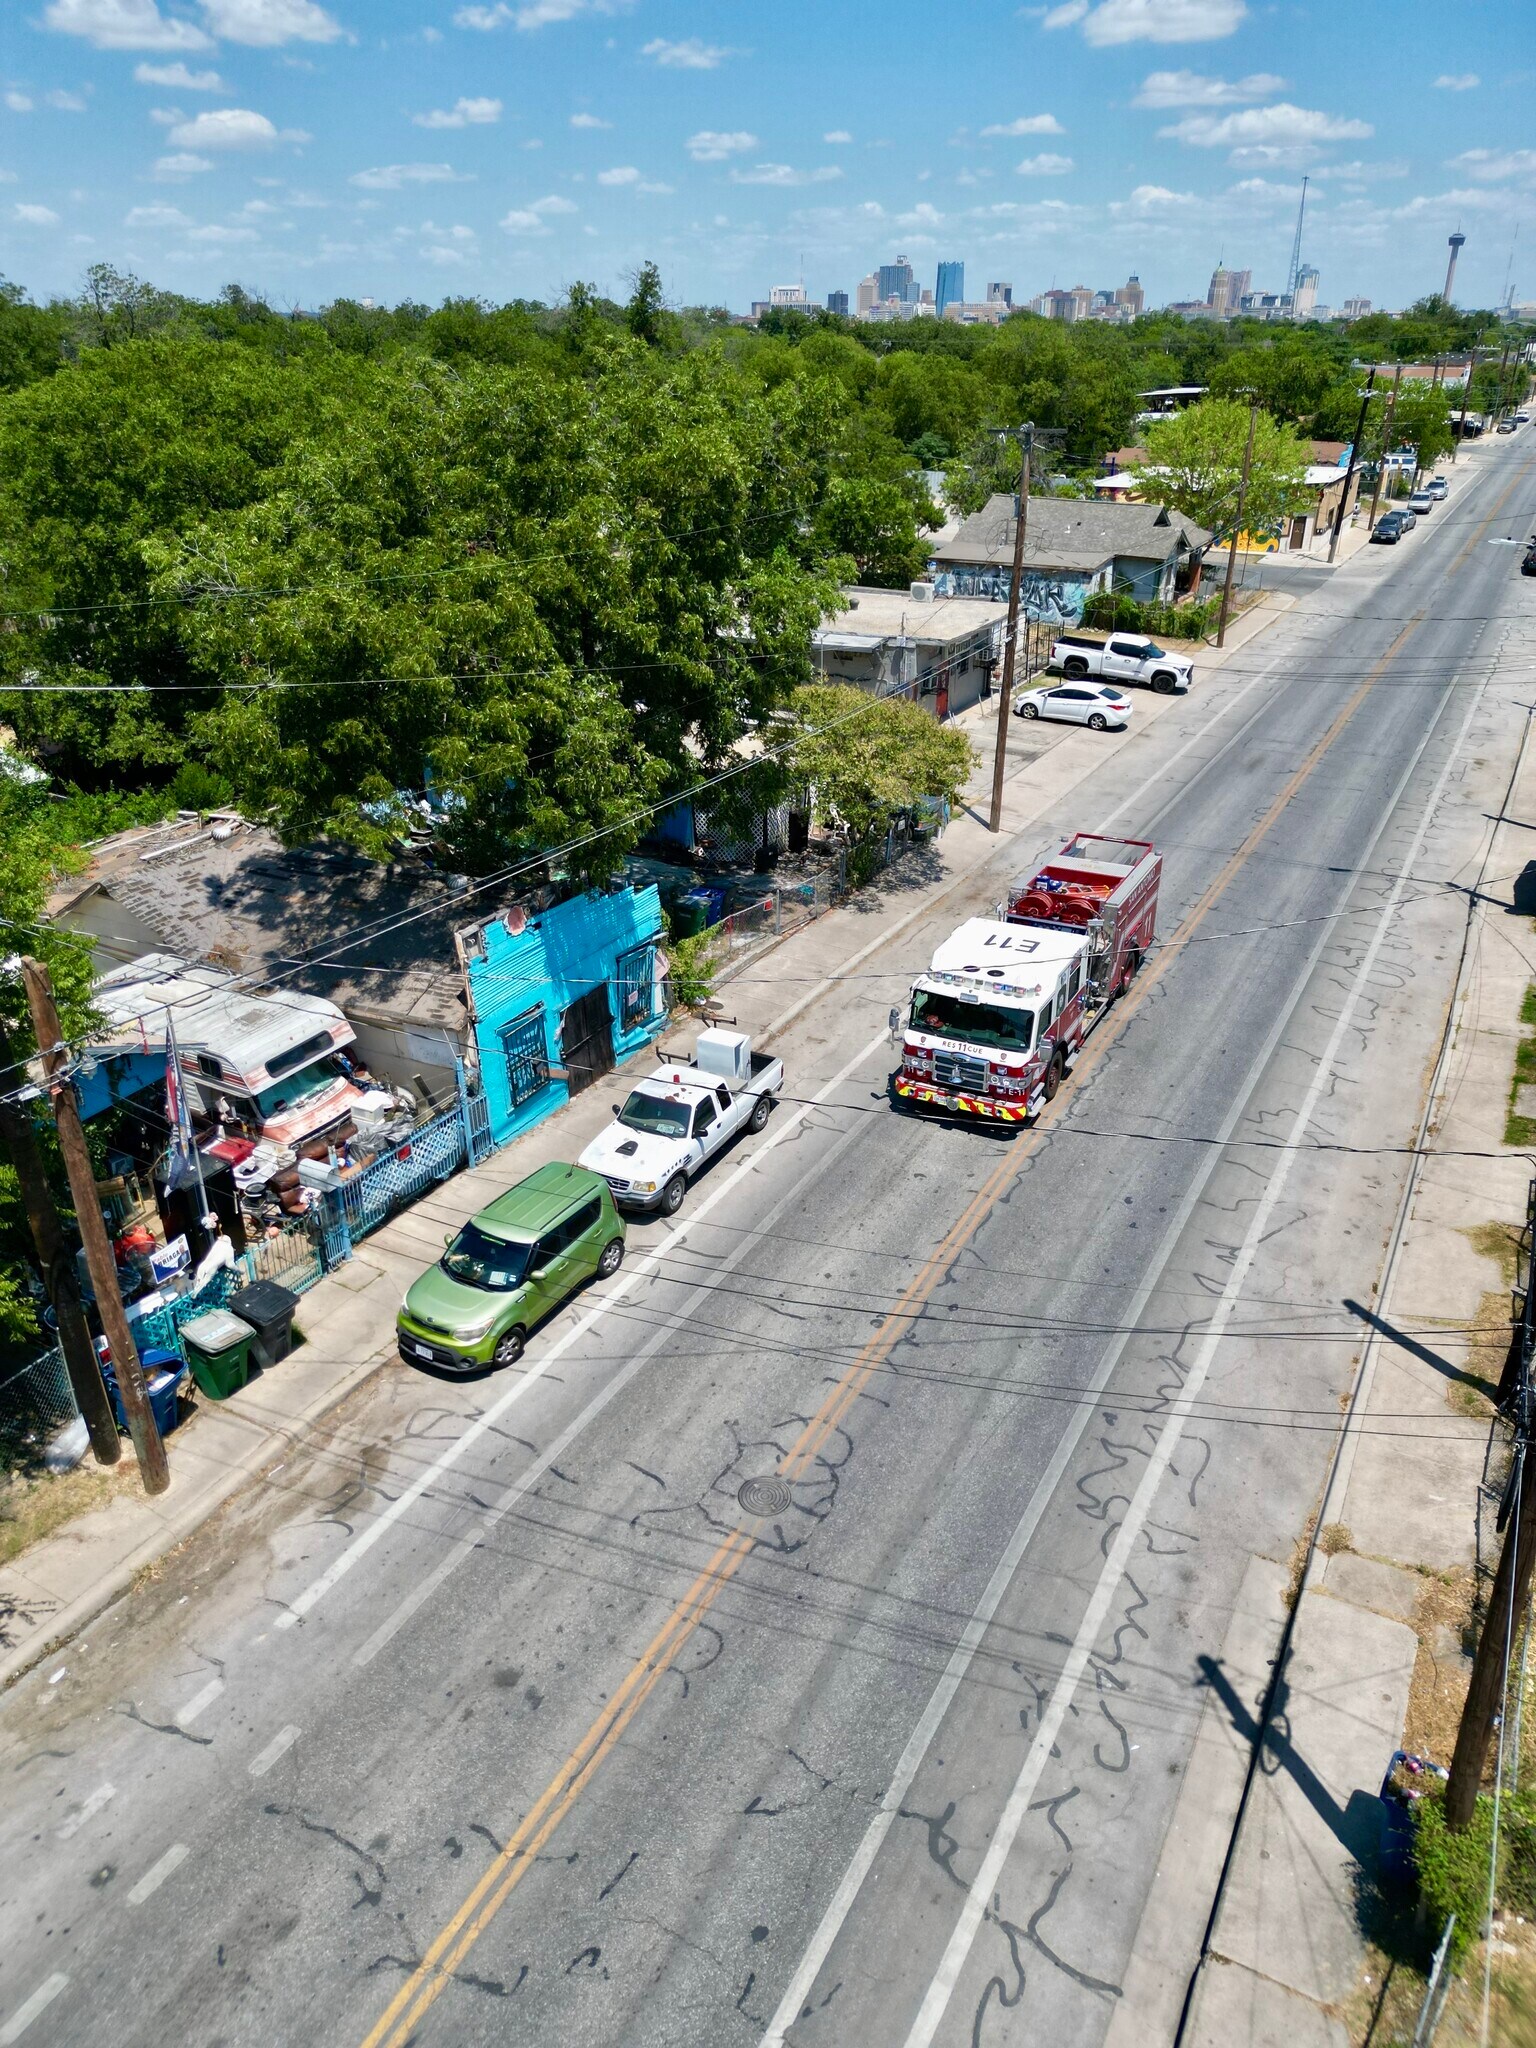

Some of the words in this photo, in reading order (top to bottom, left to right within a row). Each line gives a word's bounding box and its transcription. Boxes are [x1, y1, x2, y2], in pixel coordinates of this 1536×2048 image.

[1144, 911, 1153, 938] 11
[983, 934, 1041, 954] E11
[1008, 1088, 1026, 1097] E-11
